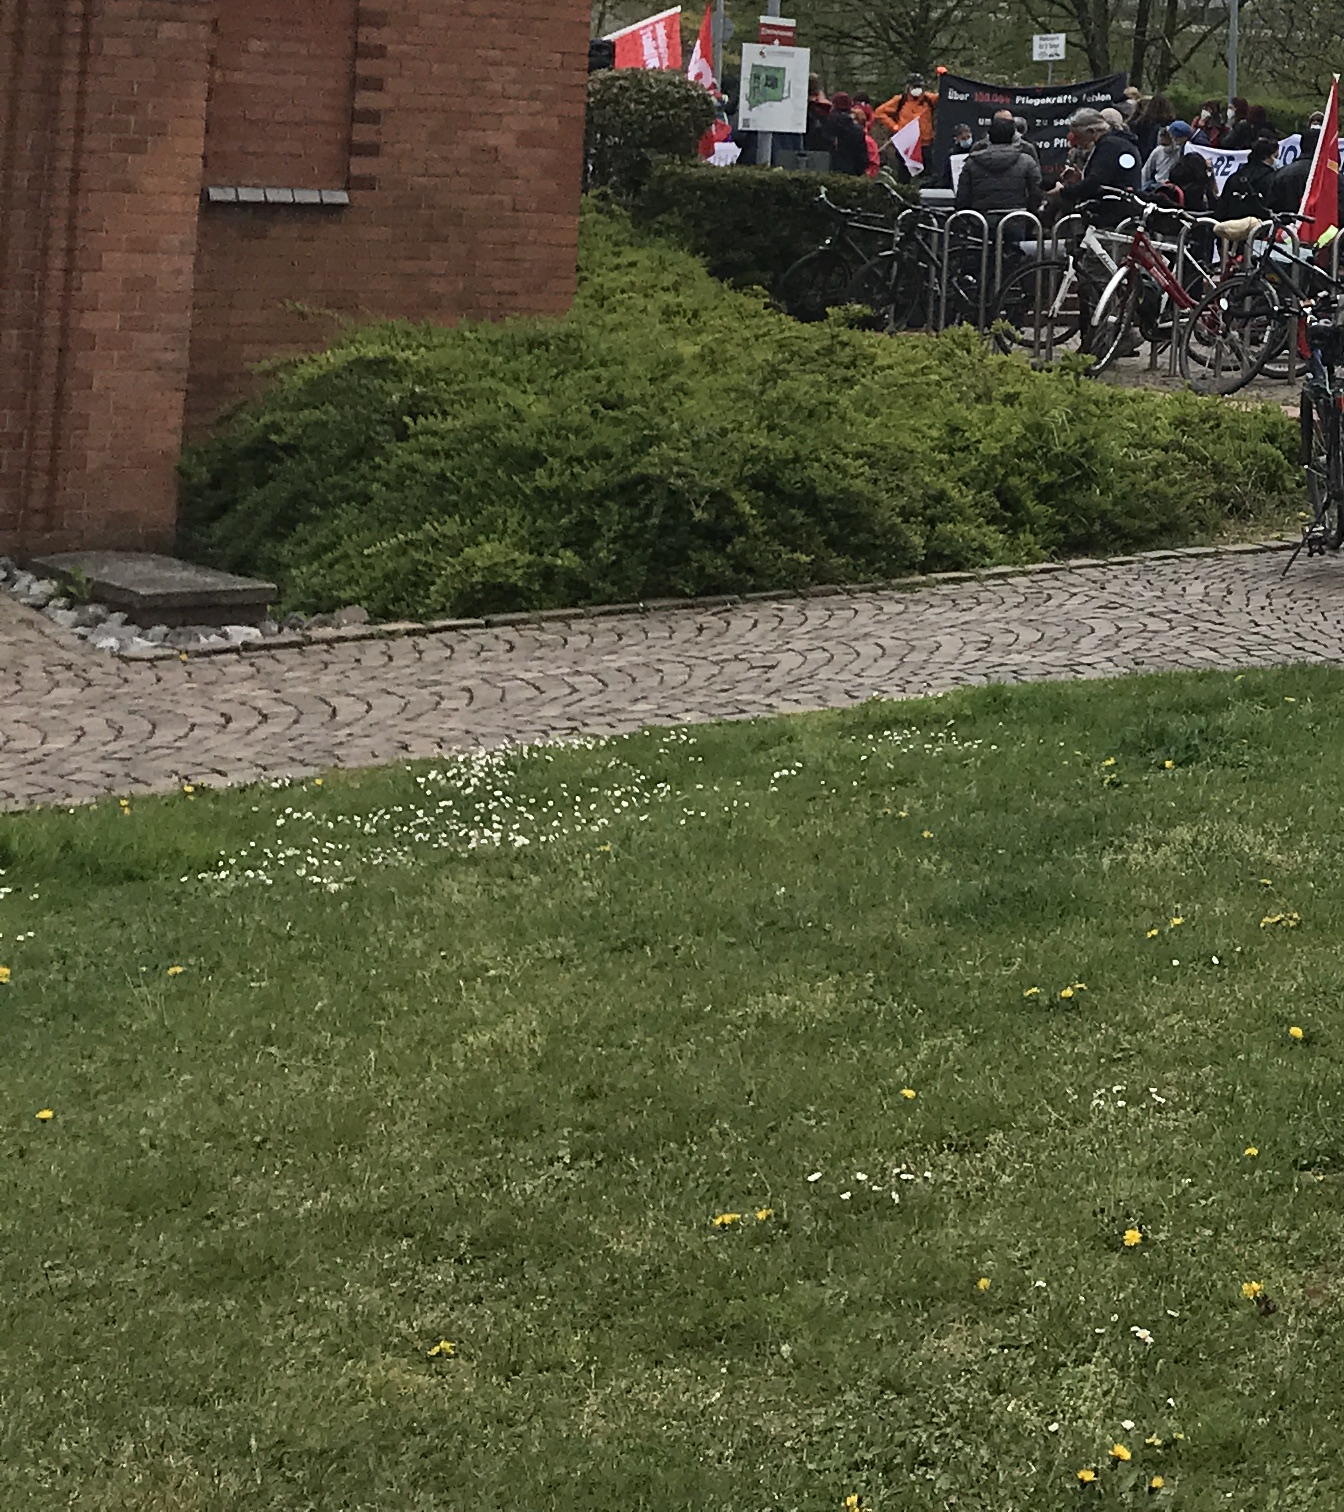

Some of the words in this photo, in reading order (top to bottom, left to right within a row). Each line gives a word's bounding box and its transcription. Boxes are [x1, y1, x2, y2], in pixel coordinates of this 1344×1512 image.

[948, 88, 970, 101] Über
[1015, 94, 1078, 107] Pflegekräfte
[1082, 92, 1112, 102] fehlen
